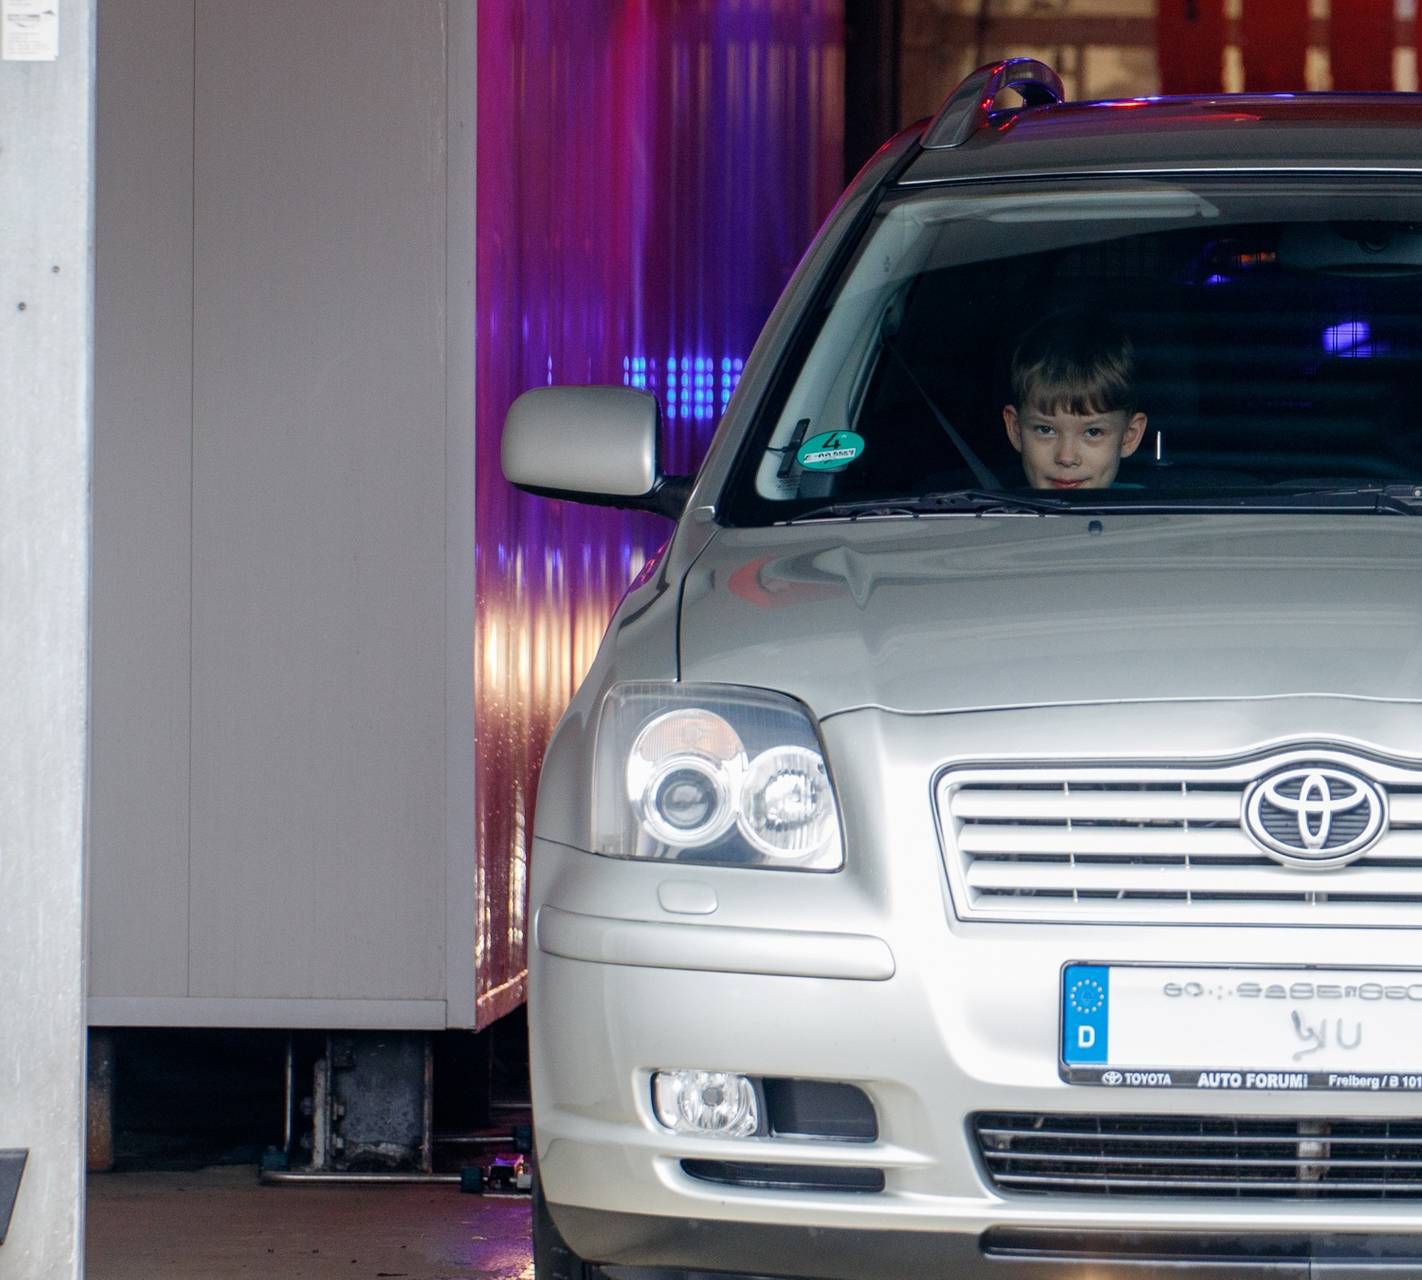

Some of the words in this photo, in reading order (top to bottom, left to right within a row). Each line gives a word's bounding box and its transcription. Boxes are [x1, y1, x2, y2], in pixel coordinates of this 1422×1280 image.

[822, 432, 841, 449] 4
[1077, 1025, 1096, 1048] D
[1124, 1072, 1172, 1086] TOYOTA
[1197, 1072, 1242, 1088] AUTO
[1328, 1074, 1380, 1090] Freiberg
[1389, 1075, 1400, 1088] B
[1402, 1075, 1422, 1089] 101
